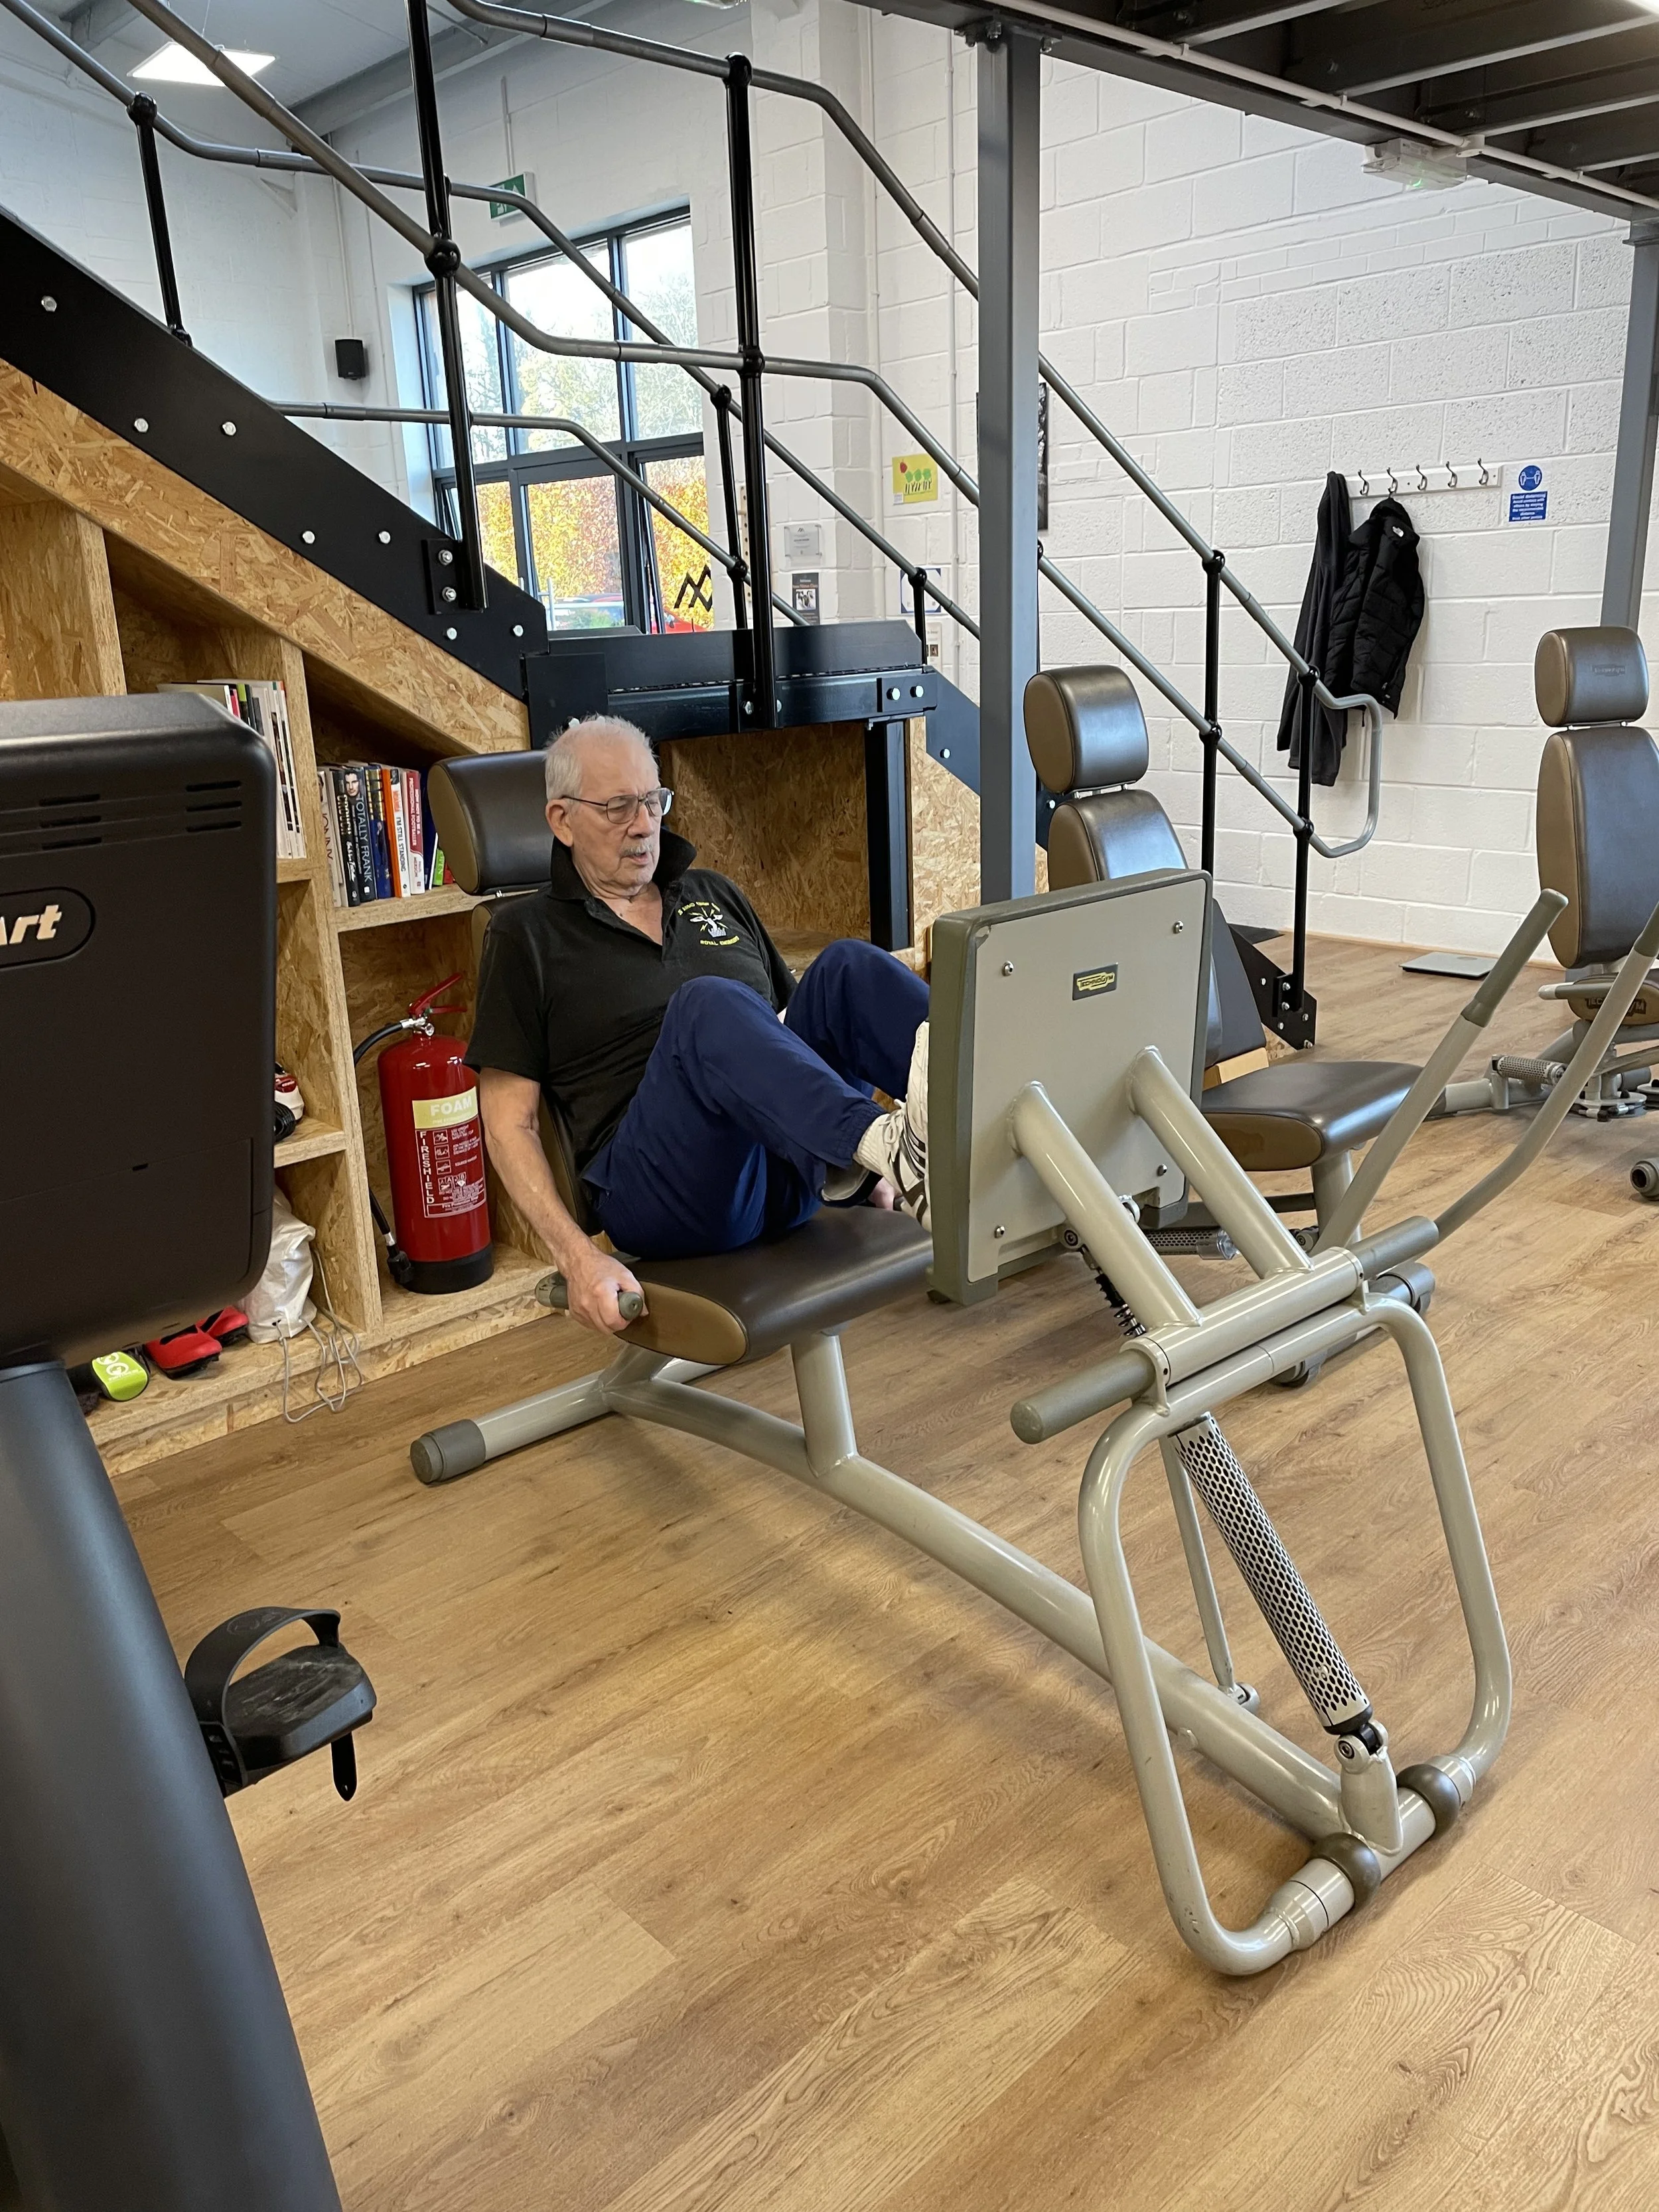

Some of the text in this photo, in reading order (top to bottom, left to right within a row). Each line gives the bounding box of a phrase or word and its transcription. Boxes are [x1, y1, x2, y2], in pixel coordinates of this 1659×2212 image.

[356, 796, 373, 883] TOTALLY FRANK
[430, 1096, 472, 1116] FOAM
[420, 1131, 435, 1204] FIRESHIELD
